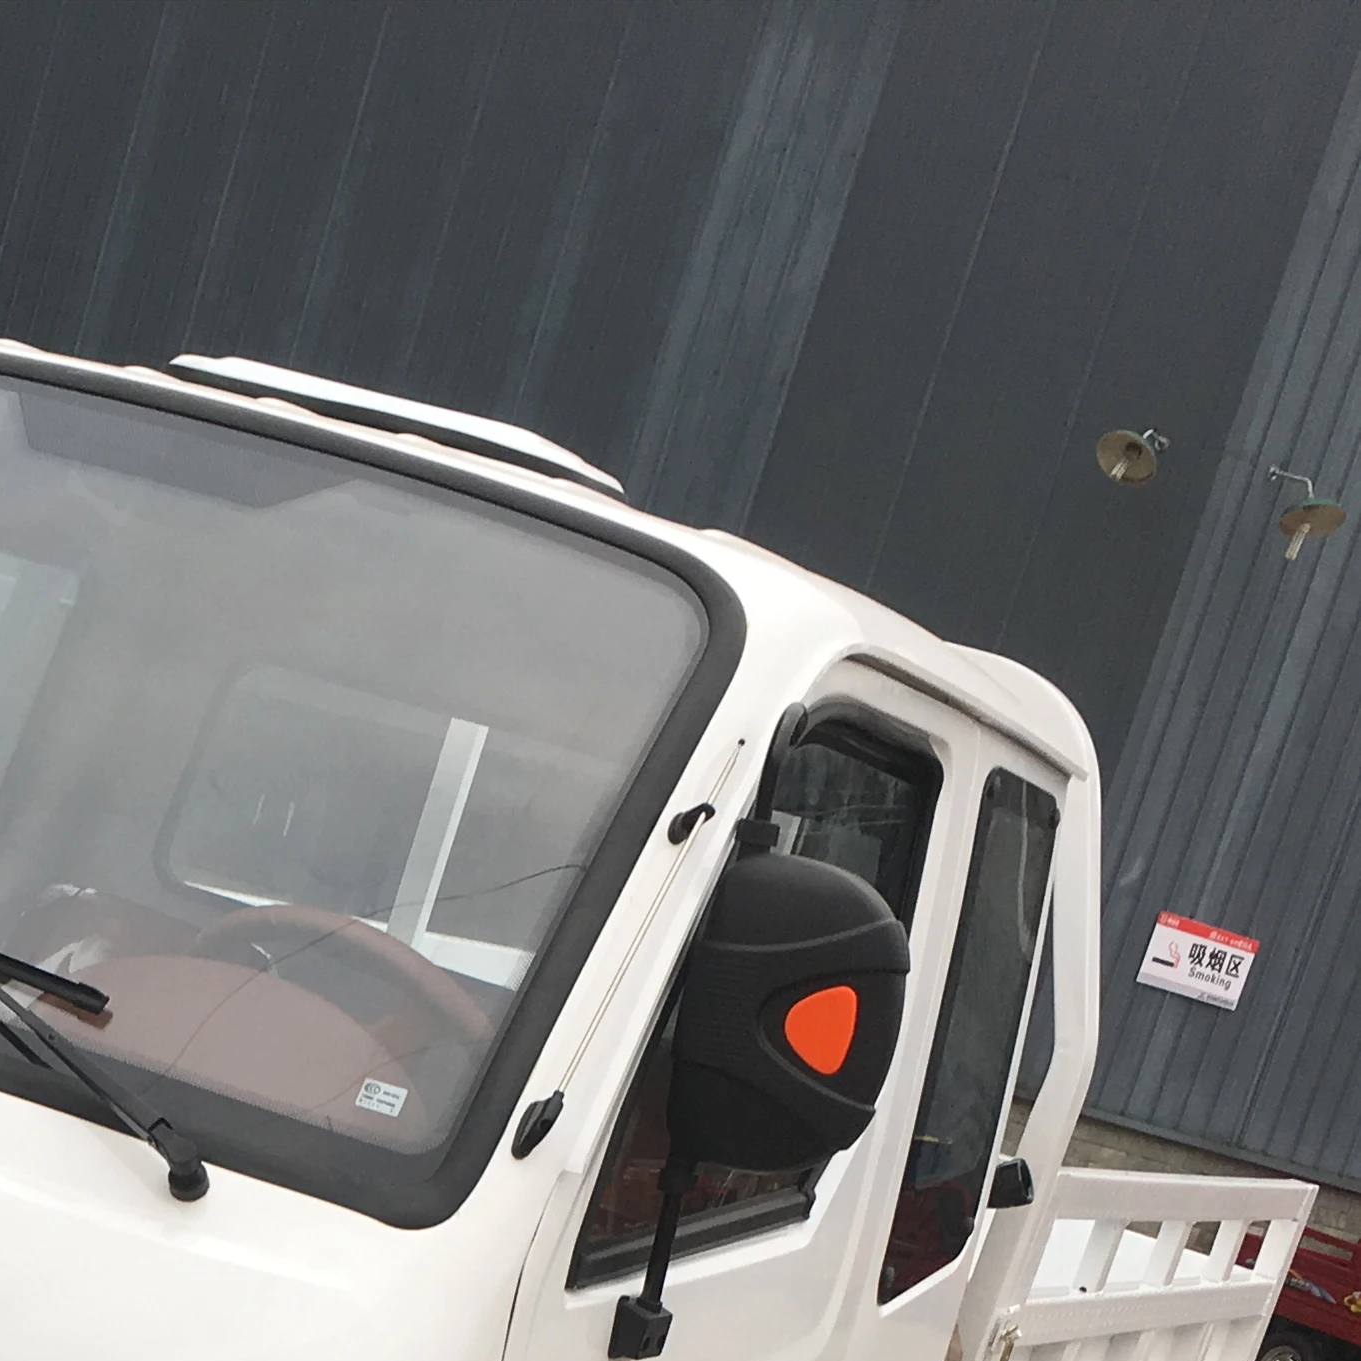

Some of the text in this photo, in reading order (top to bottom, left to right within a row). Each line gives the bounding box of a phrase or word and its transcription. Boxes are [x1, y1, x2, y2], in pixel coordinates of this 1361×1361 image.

[1188, 943, 1245, 978] 吸烟区
[1188, 967, 1232, 991] Smoking
